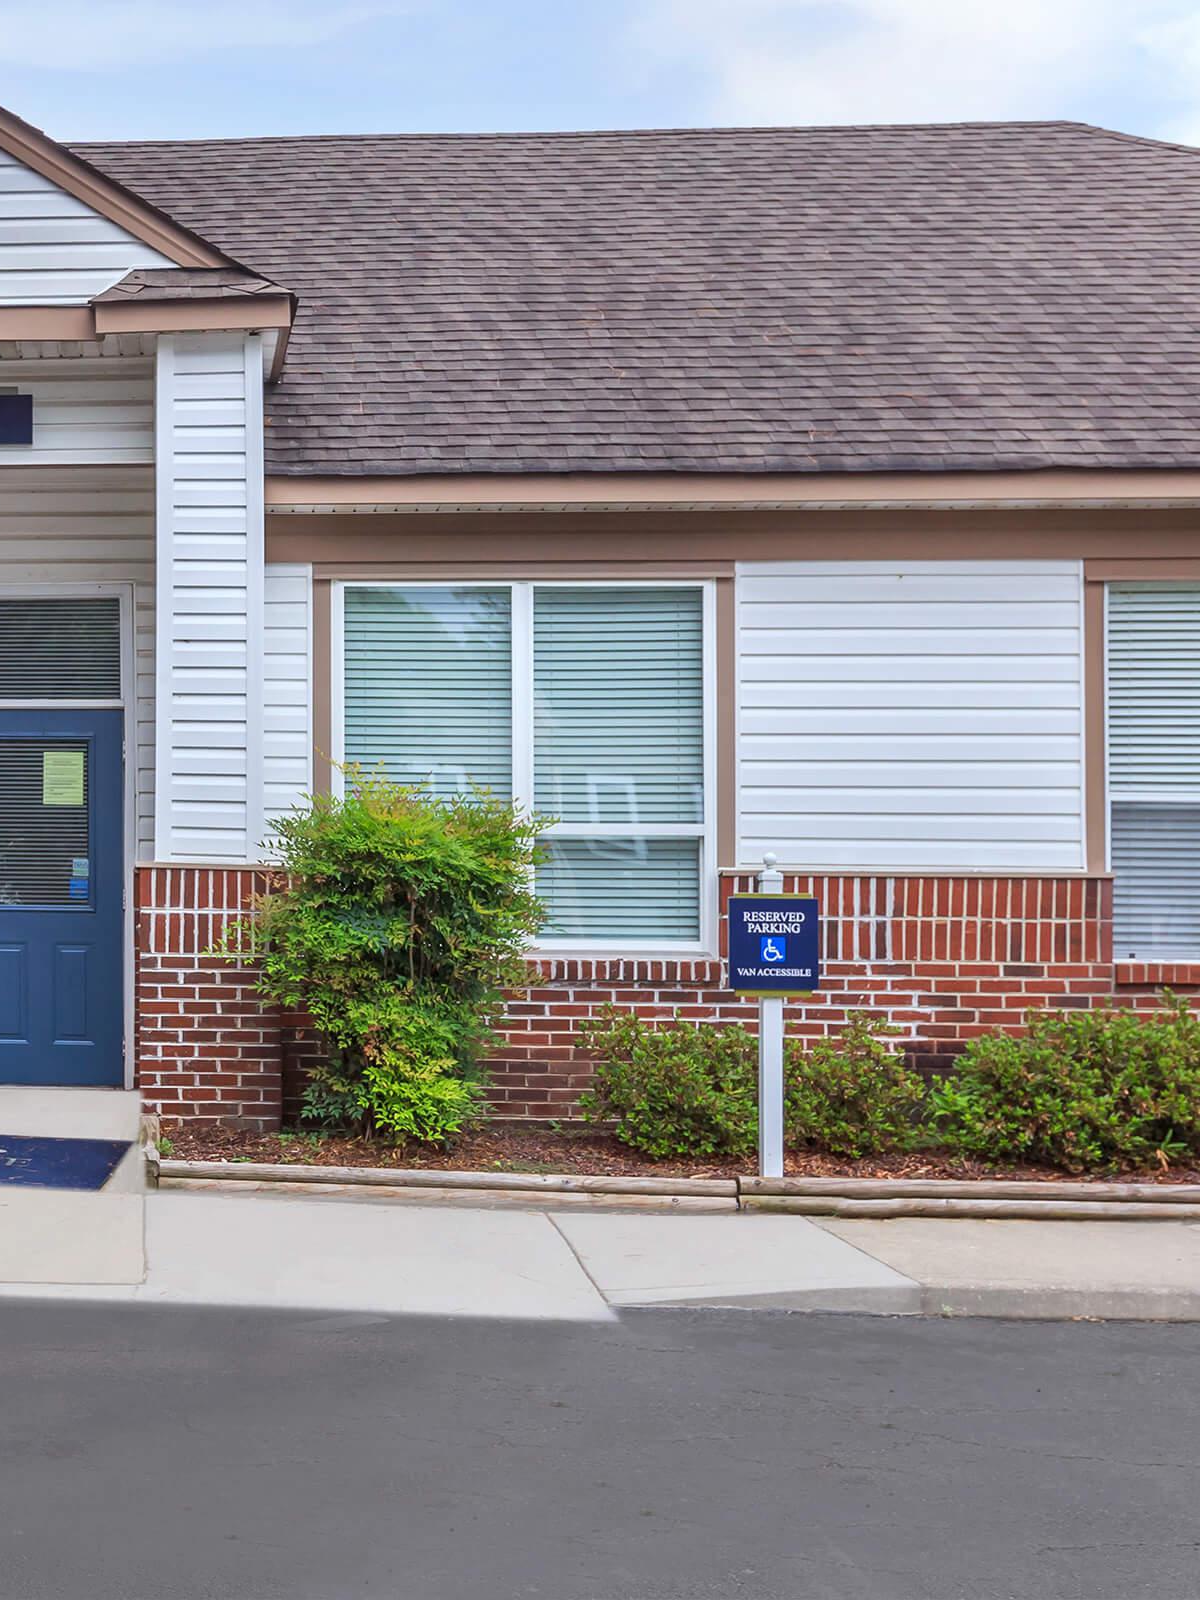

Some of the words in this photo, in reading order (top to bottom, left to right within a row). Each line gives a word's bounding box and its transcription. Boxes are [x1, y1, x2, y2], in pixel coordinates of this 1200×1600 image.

[743, 912, 805, 922] RESERVED
[747, 923, 801, 934] PARKING
[737, 968, 756, 976] VAN
[757, 968, 812, 977] ACCESSIBLE
